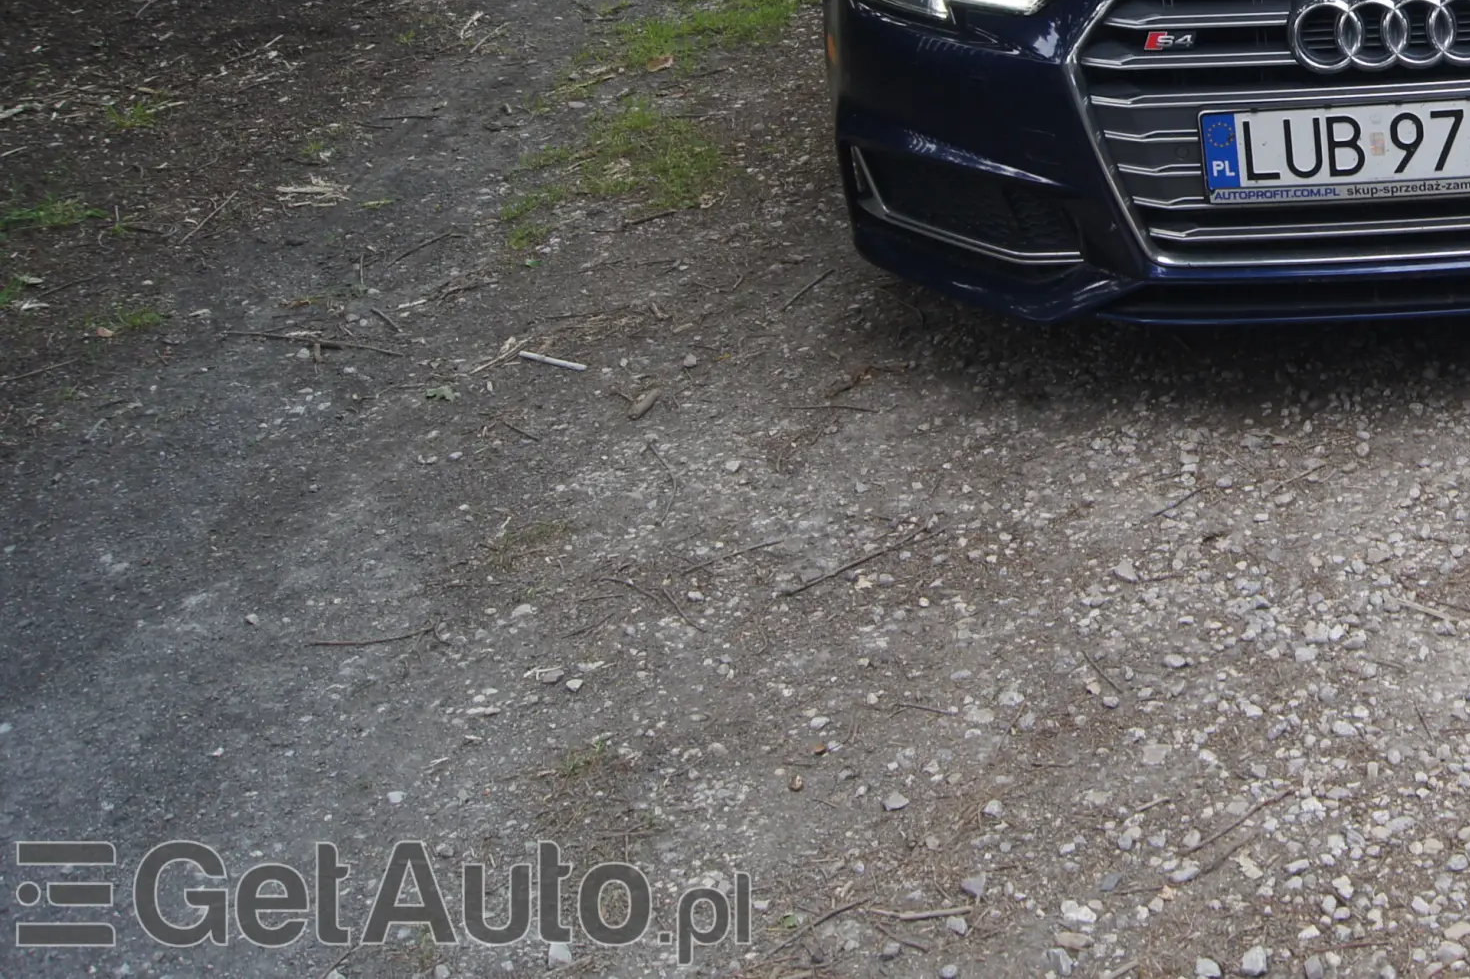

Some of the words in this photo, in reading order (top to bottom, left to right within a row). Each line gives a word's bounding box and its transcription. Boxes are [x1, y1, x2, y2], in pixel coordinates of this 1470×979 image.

[1156, 34, 1194, 48] S4
[1242, 115, 1366, 181] LUB
[1212, 160, 1236, 177] PL
[1214, 187, 1341, 201] AUTOPROFIT.COM.PL
